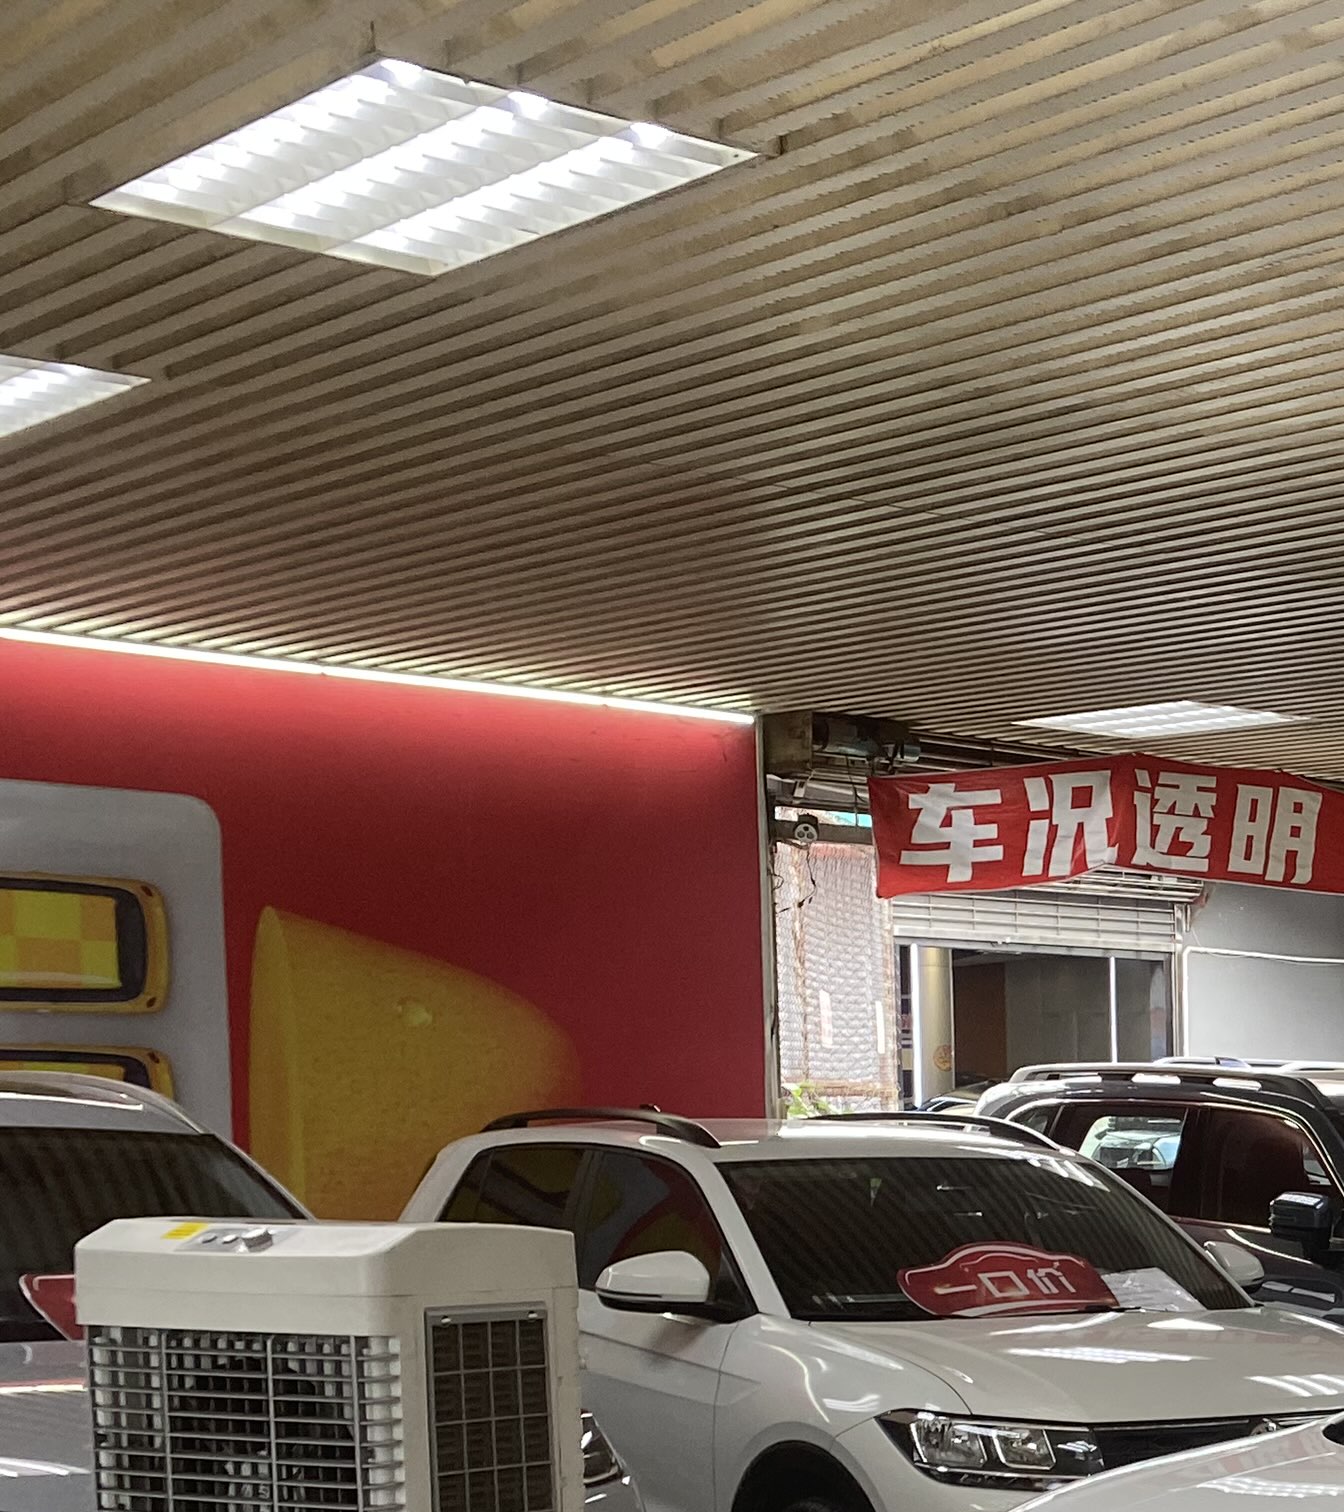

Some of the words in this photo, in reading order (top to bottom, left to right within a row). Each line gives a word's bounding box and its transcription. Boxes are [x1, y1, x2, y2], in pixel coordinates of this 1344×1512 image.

[900, 769, 1322, 884] 车况透明
[934, 1262, 1077, 1298] 一口价
